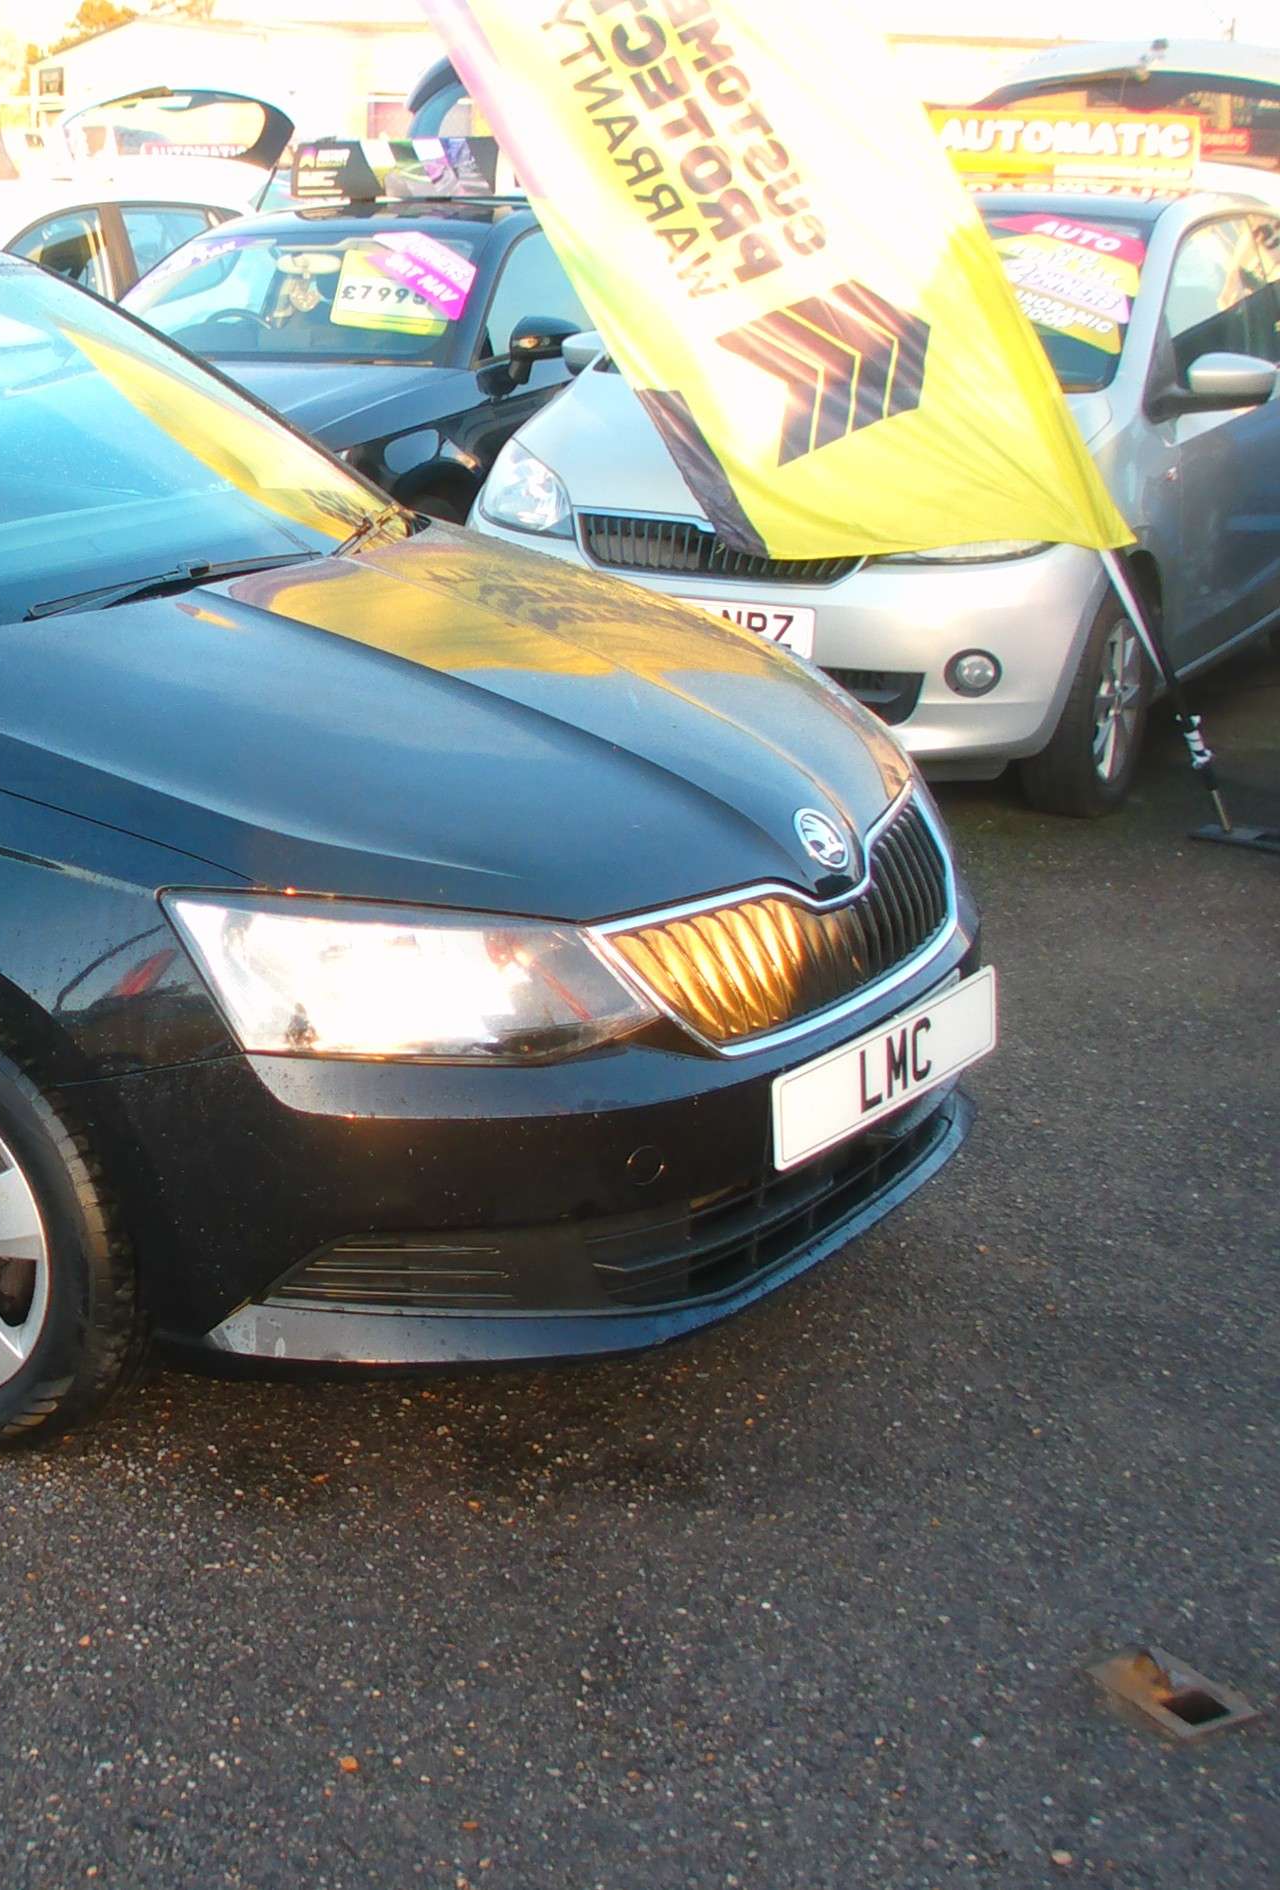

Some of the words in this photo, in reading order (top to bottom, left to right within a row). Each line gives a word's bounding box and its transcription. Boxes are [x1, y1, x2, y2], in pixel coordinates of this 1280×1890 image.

[941, 118, 1193, 158] AUTOMATIC
[1032, 221, 1121, 251] AUTO
[417, 274, 459, 302] NAV
[1015, 289, 1114, 334] ANORAMIC
[859, 1016, 932, 1114] LMC
